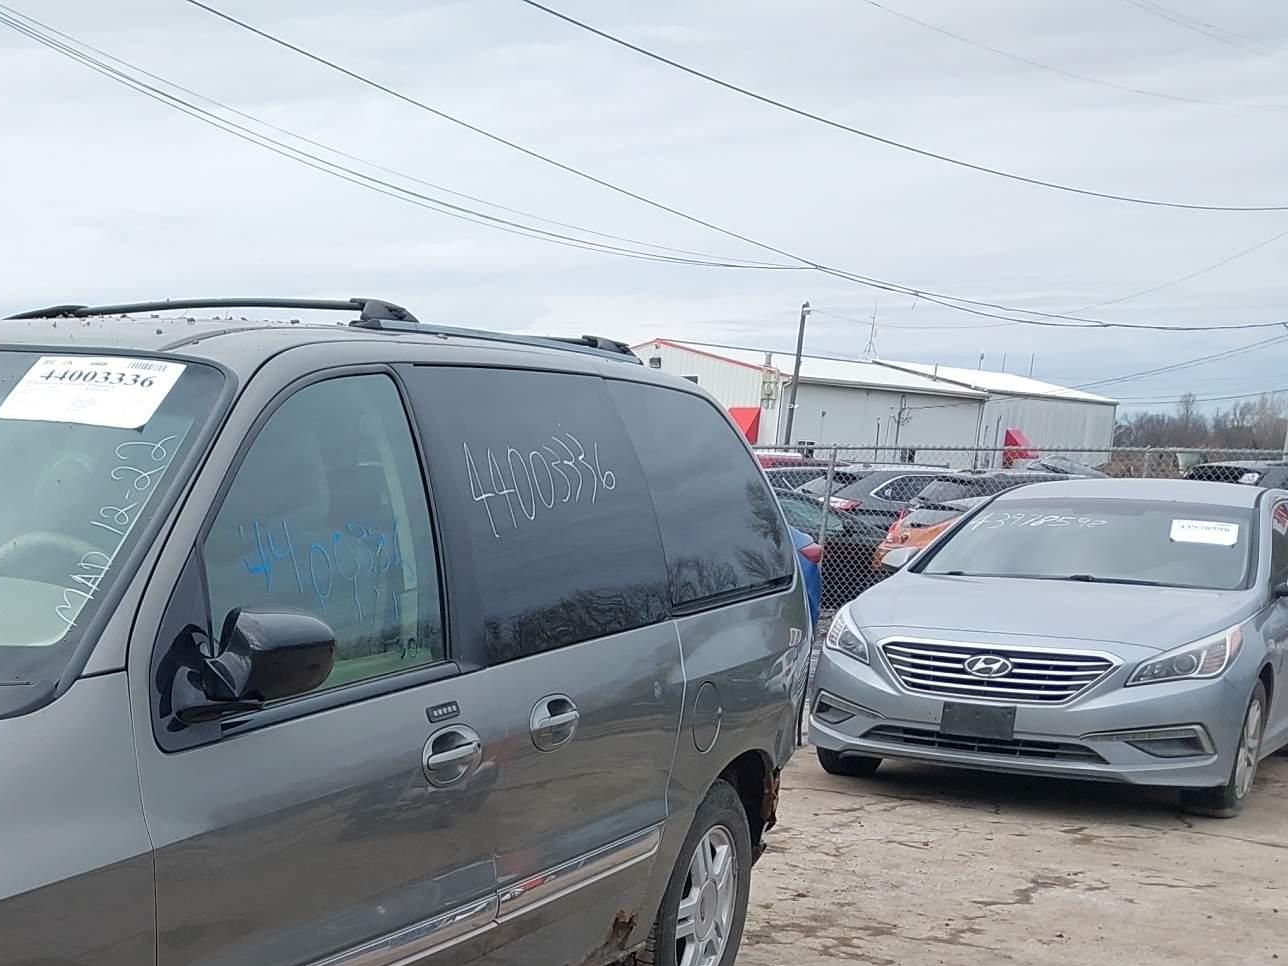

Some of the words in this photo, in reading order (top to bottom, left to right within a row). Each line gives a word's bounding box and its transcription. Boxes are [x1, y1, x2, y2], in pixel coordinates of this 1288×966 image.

[40, 368, 157, 389] 44003336
[55, 551, 111, 627] MAD
[91, 434, 178, 536] 12-22
[463, 432, 617, 538] 44003336
